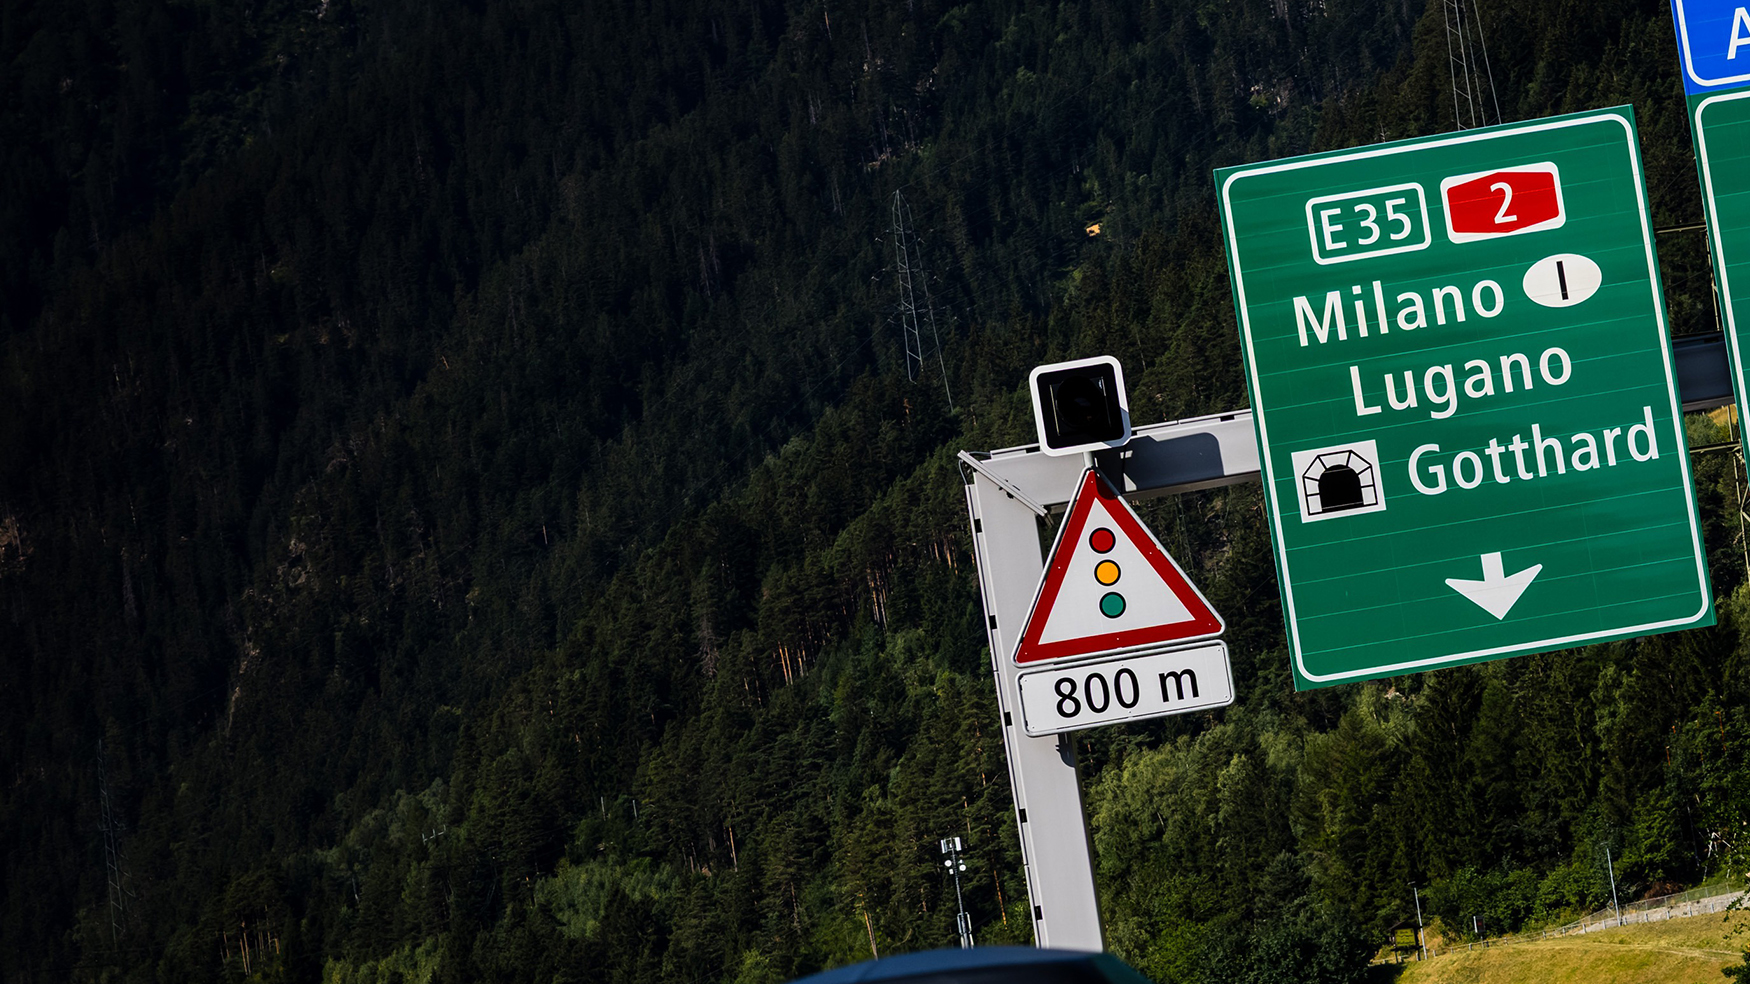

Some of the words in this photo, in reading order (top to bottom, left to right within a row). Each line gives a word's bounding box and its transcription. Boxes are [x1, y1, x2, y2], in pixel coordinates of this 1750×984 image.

[1320, 197, 1412, 251] E35
[1490, 181, 1518, 225] 2
[1292, 279, 1505, 347] Milano
[1349, 347, 1572, 420] Lugano
[1408, 405, 1660, 496] Gotthard
[1054, 667, 1140, 719] 800
[1158, 668, 1200, 703] m
